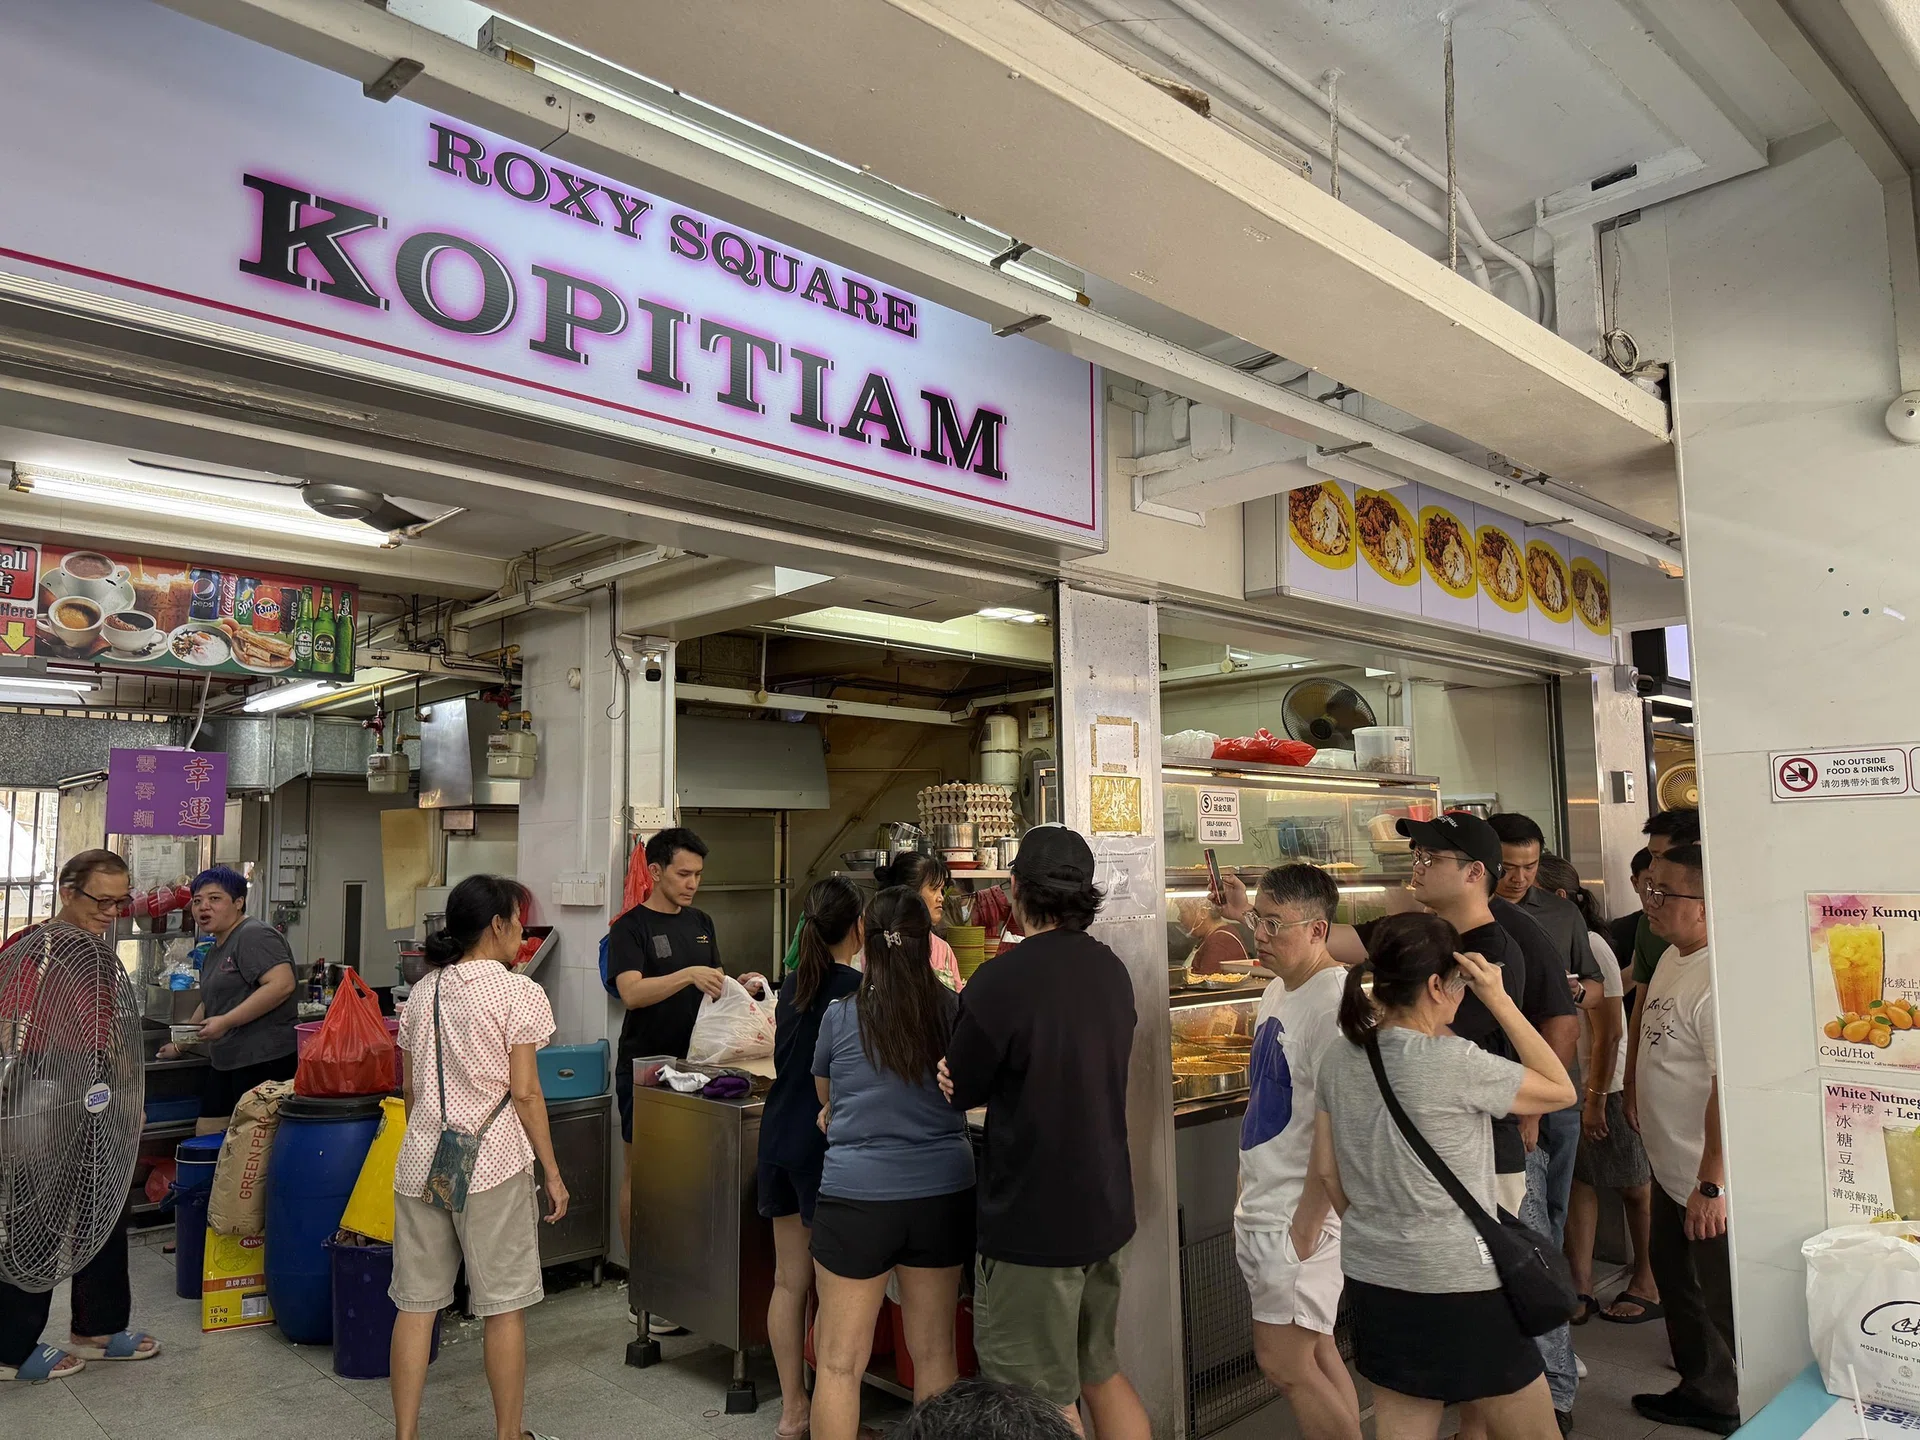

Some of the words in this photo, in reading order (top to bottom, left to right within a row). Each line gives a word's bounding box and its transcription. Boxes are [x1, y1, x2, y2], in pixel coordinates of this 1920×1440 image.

[429, 122, 653, 239] ROXY
[669, 213, 919, 339] SQUARE
[238, 173, 1009, 481] KOPITIAM
[0, 602, 34, 618] Here
[192, 600, 214, 609] pepsi
[238, 598, 254, 616] Spri
[254, 603, 280, 614] Fanta
[290, 601, 298, 621] zero
[314, 643, 334, 653] Chang
[1826, 767, 1851, 775] FOOD
[1852, 766, 1860, 774] &
[1861, 764, 1895, 774] DRINKS
[1832, 759, 1846, 767] NO
[1847, 756, 1886, 766] OUTSIDE
[1820, 776, 1900, 789] 请勿携带外面食物
[178, 756, 215, 830] 幸運
[1821, 905, 1868, 920] Honey
[1872, 906, 1920, 922] Kumq
[1883, 977, 1920, 989] 化痰止
[1819, 1045, 1875, 1060] Cold/Hot
[1826, 1085, 1867, 1100] White
[1835, 1114, 1855, 1185] 冰糖豆蔻
[239, 1151, 262, 1200] GREEN
[1860, 1343, 1909, 1361] MODERNIZING
